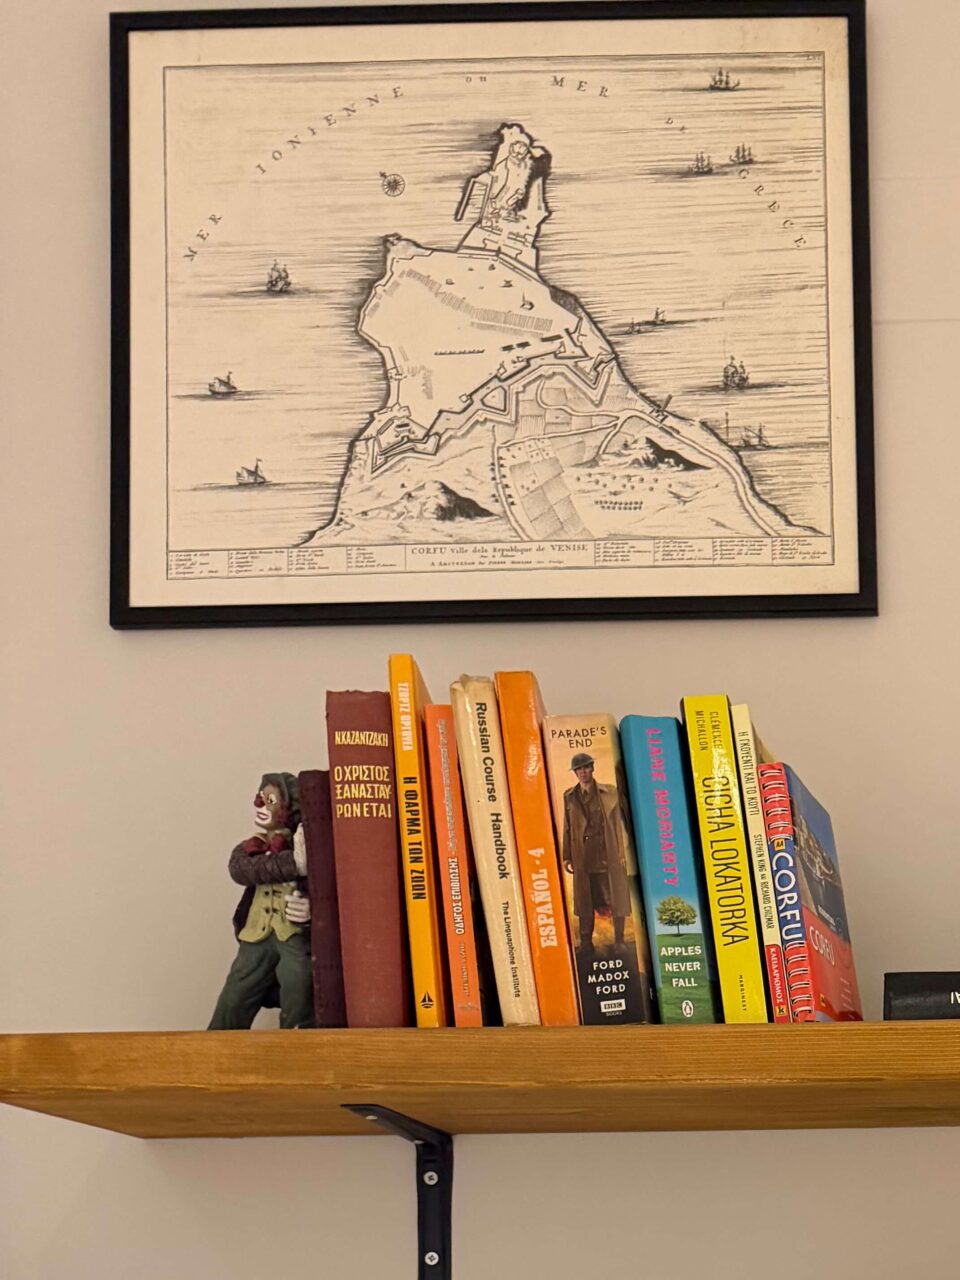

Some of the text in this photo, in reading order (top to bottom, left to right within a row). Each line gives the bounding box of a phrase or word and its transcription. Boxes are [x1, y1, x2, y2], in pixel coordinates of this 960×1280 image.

[551, 75, 610, 98] MER
[183, 86, 404, 262] MER IONIENNE
[411, 546, 448, 555] CORFU
[550, 543, 589, 552] VENISE
[551, 726, 608, 739] PARADE'S
[695, 710, 709, 751] MICHALLON
[334, 731, 389, 747] Ν.ΚΑΖΑΝΤΖΑΚΗ
[568, 739, 593, 749] END
[334, 765, 390, 782] Ο ΧΡΙΣΤΟΣ
[475, 701, 510, 880] Russian Course Handbook
[645, 727, 680, 888] LIANE MORIARTY
[403, 776, 427, 900] Η ΦΑΡΜΑ ΤΩΝ ΖΩΩΝ
[753, 834, 765, 858] STEPHEN
[527, 847, 545, 857] 4
[701, 775, 750, 947] CICHA LOKATORKA
[757, 859, 768, 873] KING
[771, 852, 803, 941] CORFU
[530, 868, 558, 949] ESPAÑOL
[452, 901, 465, 935] ΟΔΗΓΟΣ
[501, 901, 521, 998] The Linguaphone Institute
[660, 946, 702, 956] APPLES
[592, 959, 623, 970] FORD
[664, 962, 701, 973] NEVER
[587, 970, 630, 983] MADOX
[672, 977, 698, 988] FALL
[595, 984, 626, 995] FORD
[602, 1001, 624, 1011] BBC
